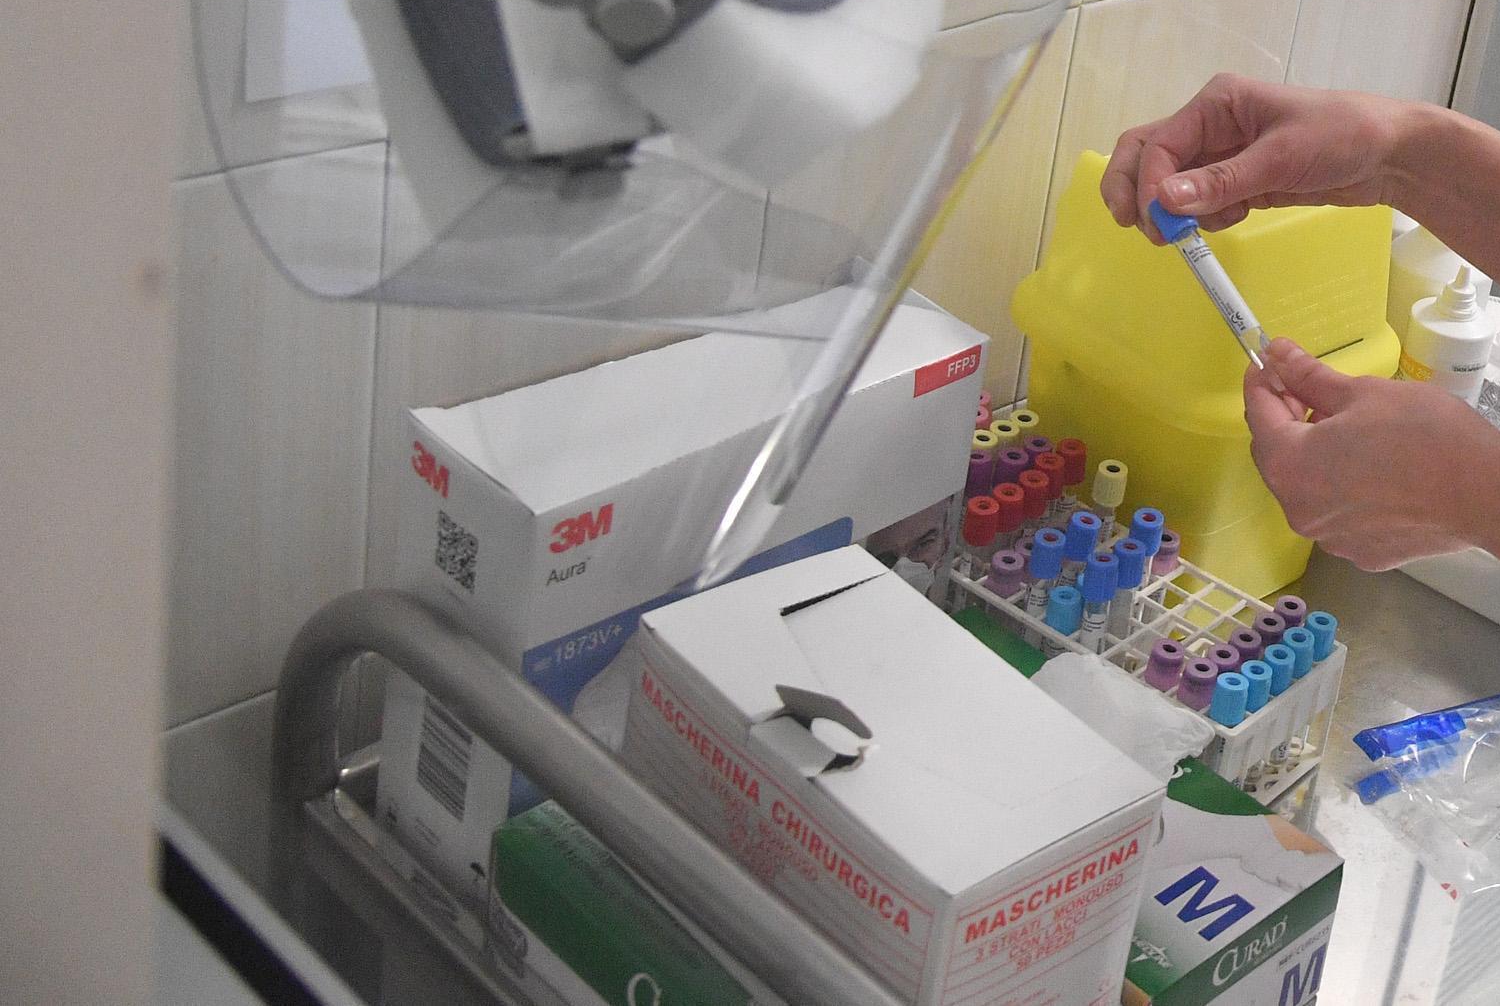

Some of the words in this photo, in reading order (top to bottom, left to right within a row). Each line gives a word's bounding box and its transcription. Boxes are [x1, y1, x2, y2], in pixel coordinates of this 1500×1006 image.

[947, 353, 976, 378] FFP3
[411, 440, 450, 498] 3M
[549, 502, 615, 554] 3M
[546, 559, 587, 586] Aura
[556, 624, 623, 663] 1873V+
[641, 669, 761, 807] MASCHERINA
[771, 799, 910, 934] CHIRURGICA
[964, 839, 1139, 944] MASCHERINA
[1053, 872, 1125, 920] MONOUSO
[1153, 865, 1256, 942] M
[1212, 914, 1289, 987] CURAD
